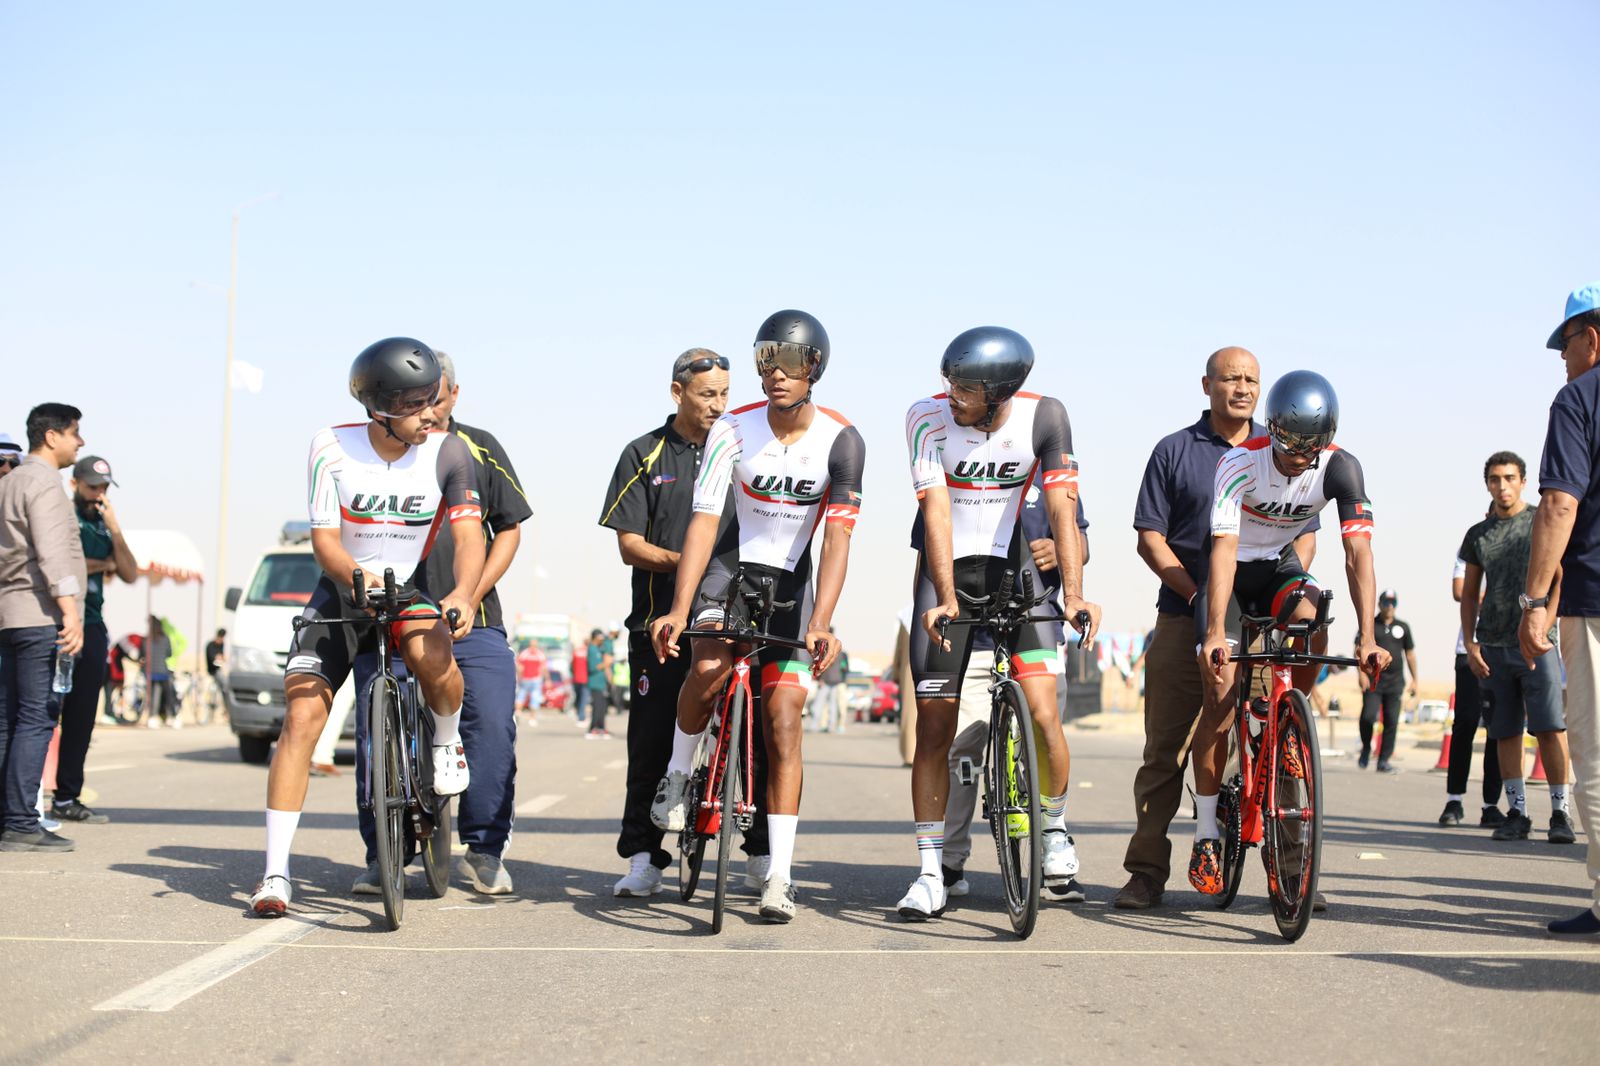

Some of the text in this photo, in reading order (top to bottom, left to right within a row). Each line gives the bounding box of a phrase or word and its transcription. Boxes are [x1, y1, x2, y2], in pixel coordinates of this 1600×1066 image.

[954, 461, 1020, 479] UAE
[751, 475, 816, 496] UAE
[351, 493, 426, 513] UAE
[953, 497, 973, 505] UNITED
[1254, 502, 1313, 516] UAE
[752, 507, 771, 517] UNITED
